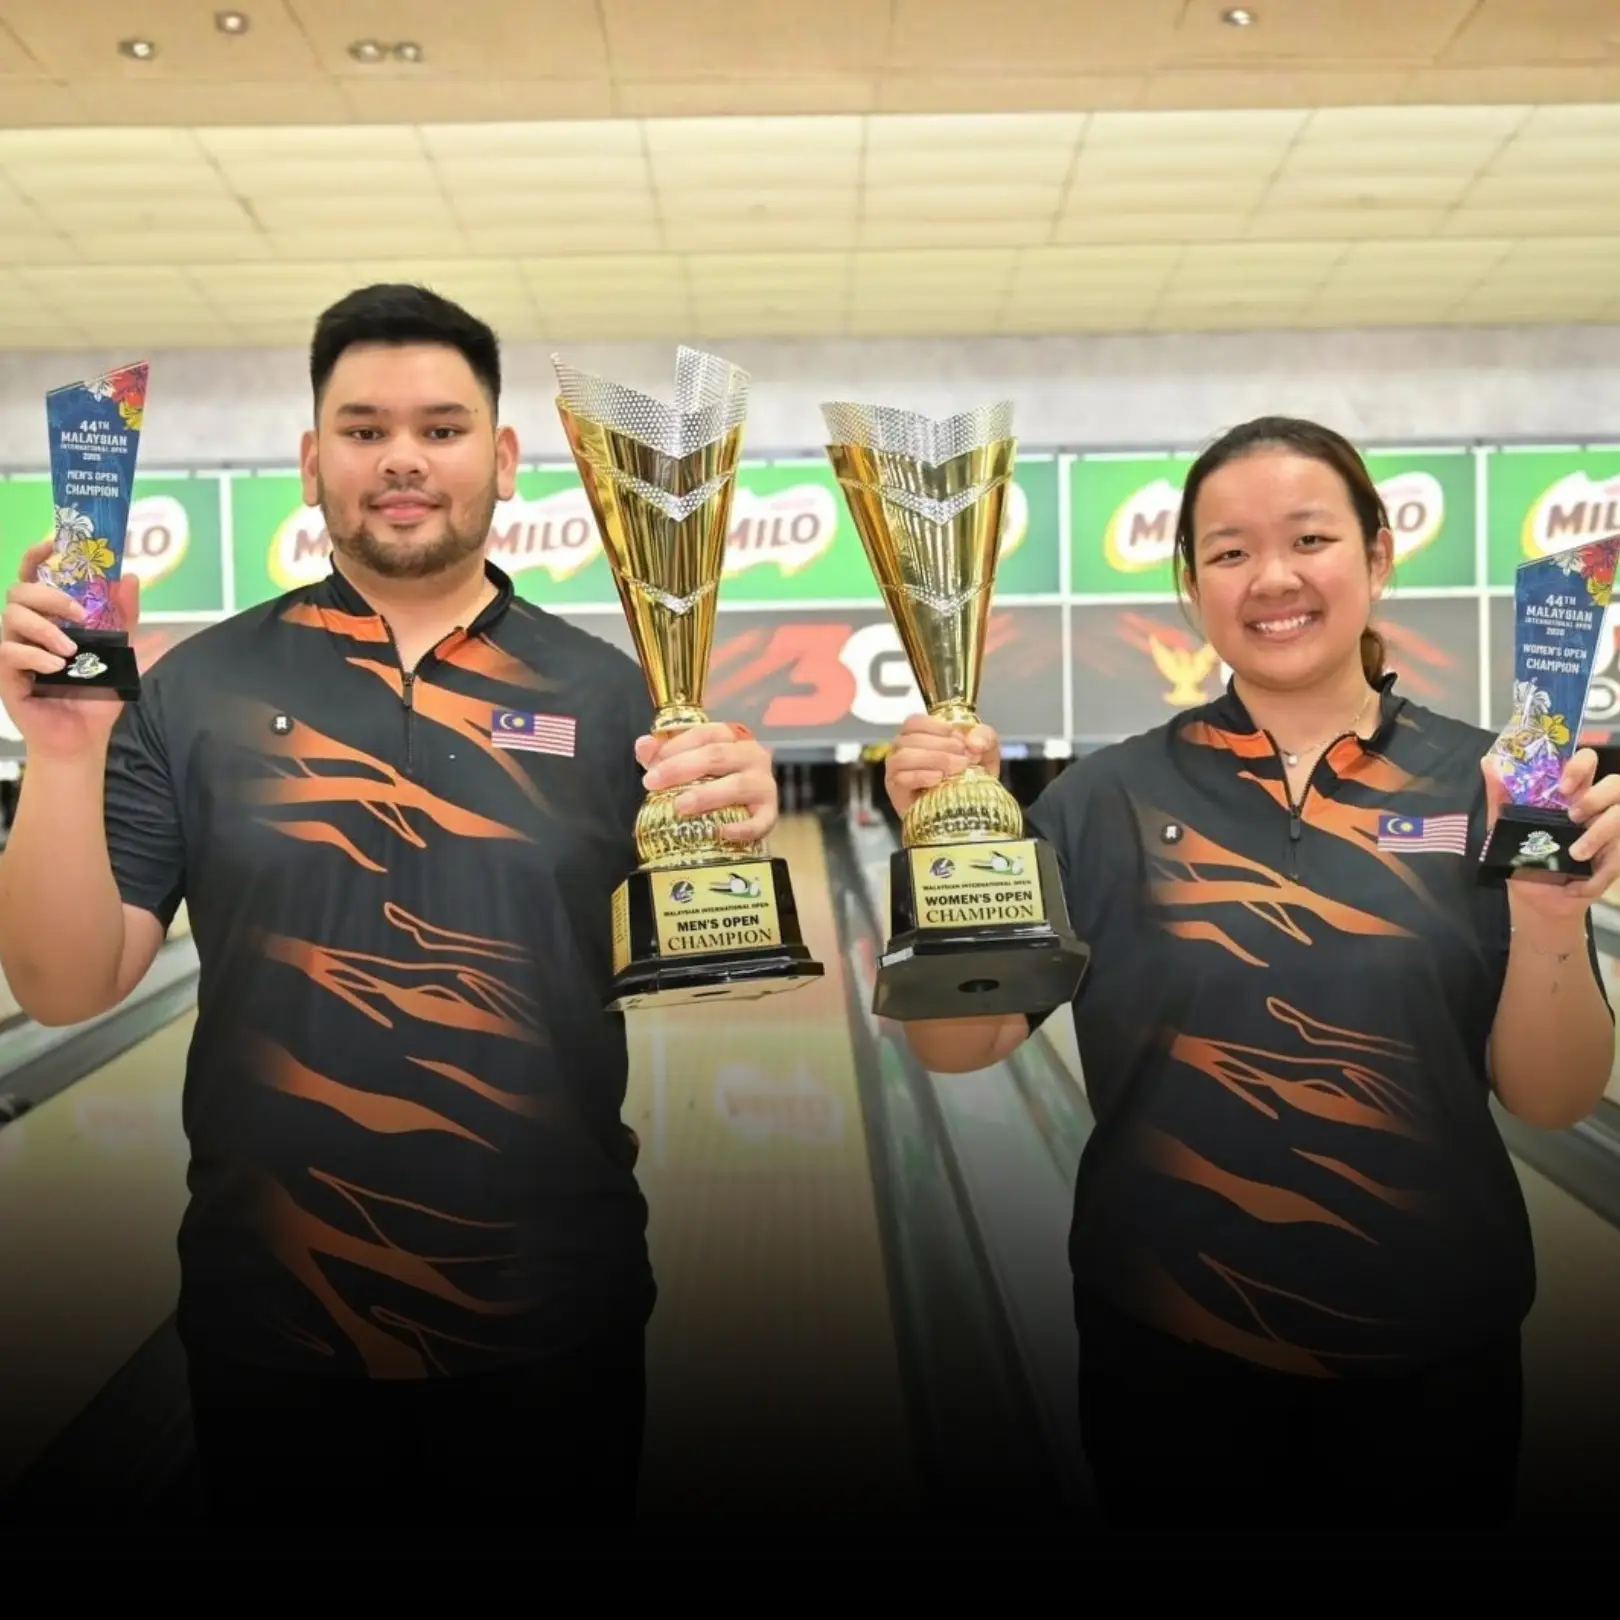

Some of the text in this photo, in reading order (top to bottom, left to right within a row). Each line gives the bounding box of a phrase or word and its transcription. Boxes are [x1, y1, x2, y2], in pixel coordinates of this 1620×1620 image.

[80, 419, 110, 432] 44TH
[61, 431, 128, 446] MALAYSIAN
[67, 469, 119, 482] MEN'S OPEN
[65, 483, 119, 498] CHAMPION
[1546, 500, 1620, 540] MIL
[1545, 594, 1577, 607] 44TH
[1526, 605, 1593, 622] MALAYSIAN
[1523, 643, 1588, 660] WOMEN'S OPEN
[1525, 657, 1581, 675] CHAMPION
[925, 890, 1033, 907] WOMEN'S OPEN
[701, 904, 750, 914] INTERNATIONAL
[926, 904, 1033, 924] CHAMPION
[677, 914, 759, 933] MEN'S OPEN
[667, 928, 773, 951] CHAMPION
